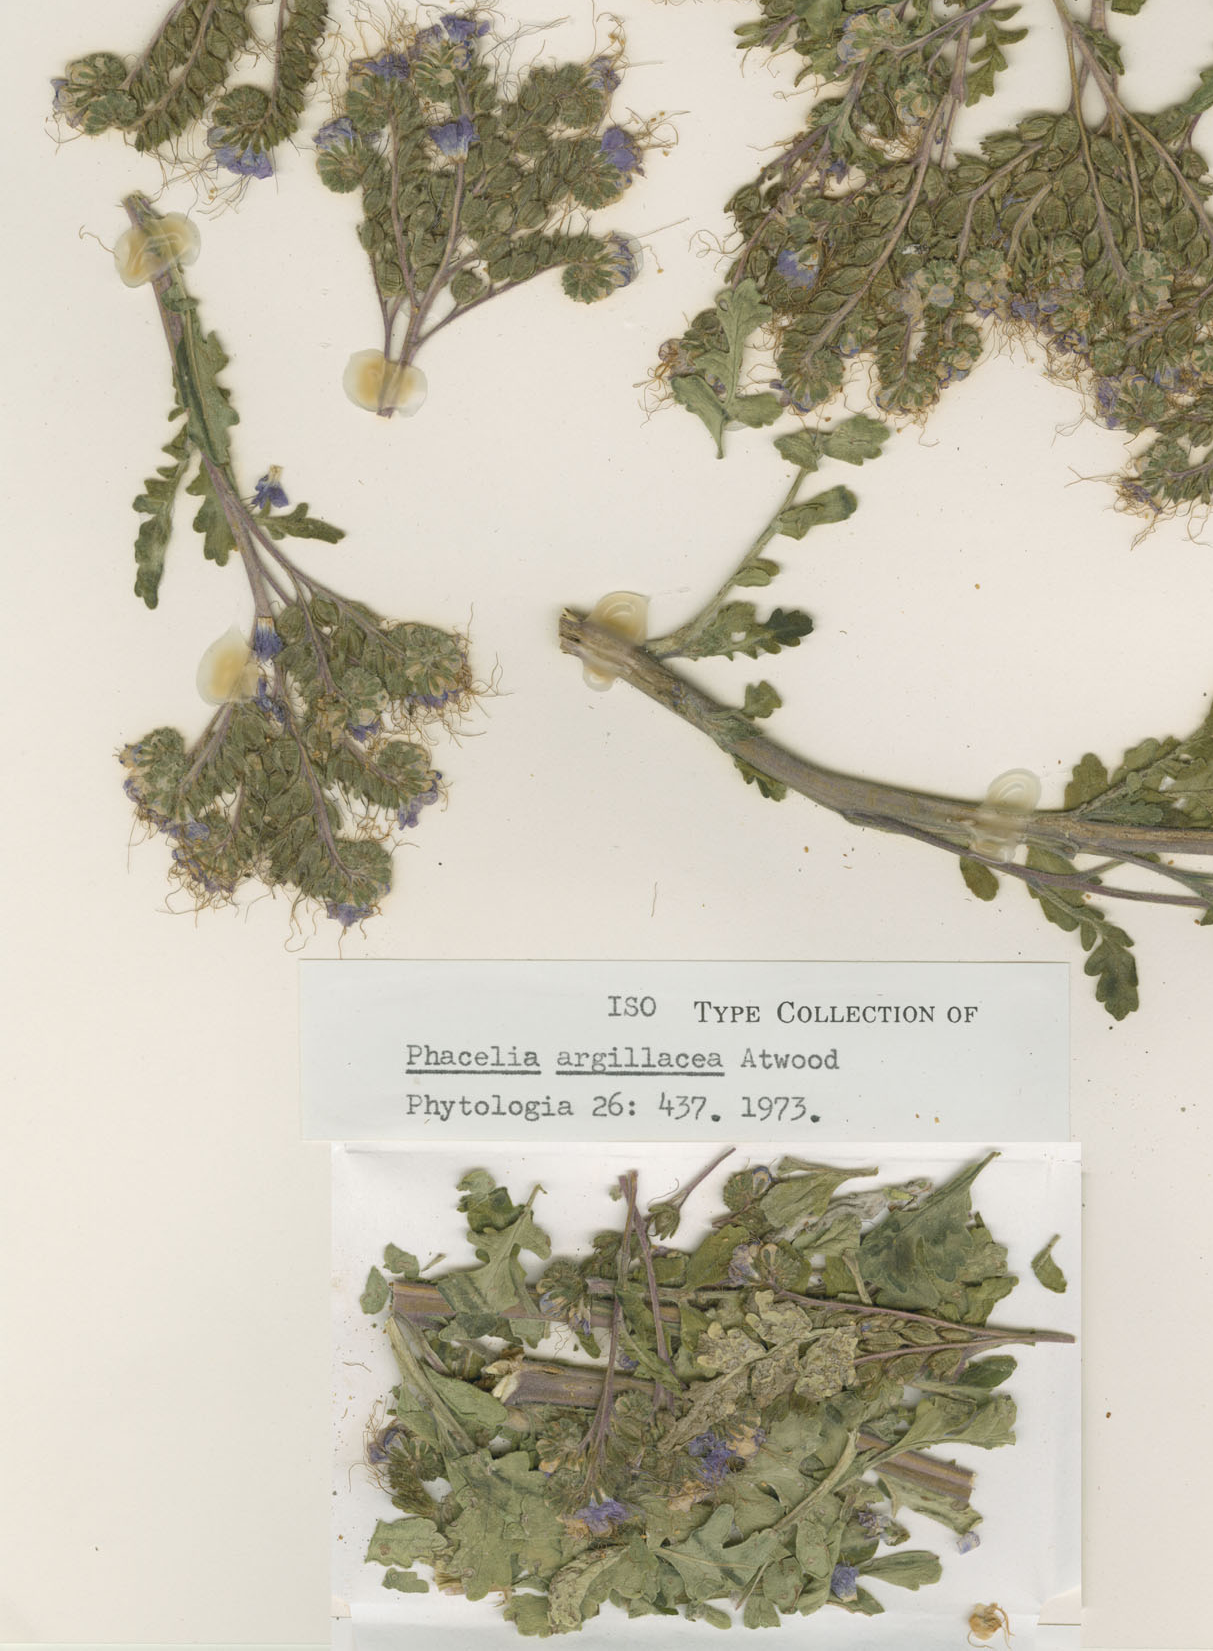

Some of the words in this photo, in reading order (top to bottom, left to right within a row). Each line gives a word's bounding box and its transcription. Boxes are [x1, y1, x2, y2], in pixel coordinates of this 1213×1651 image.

[608, 995, 658, 1017] ISO
[406, 1044, 542, 1069] Phacelia
[555, 1046, 725, 1074] argillacea
[740, 1047, 840, 1070] Atwood
[407, 1092, 575, 1122] Phytologia
[592, 1092, 638, 1118] 26:
[658, 1092, 722, 1123] 437.
[741, 1093, 822, 1123] 1973.
